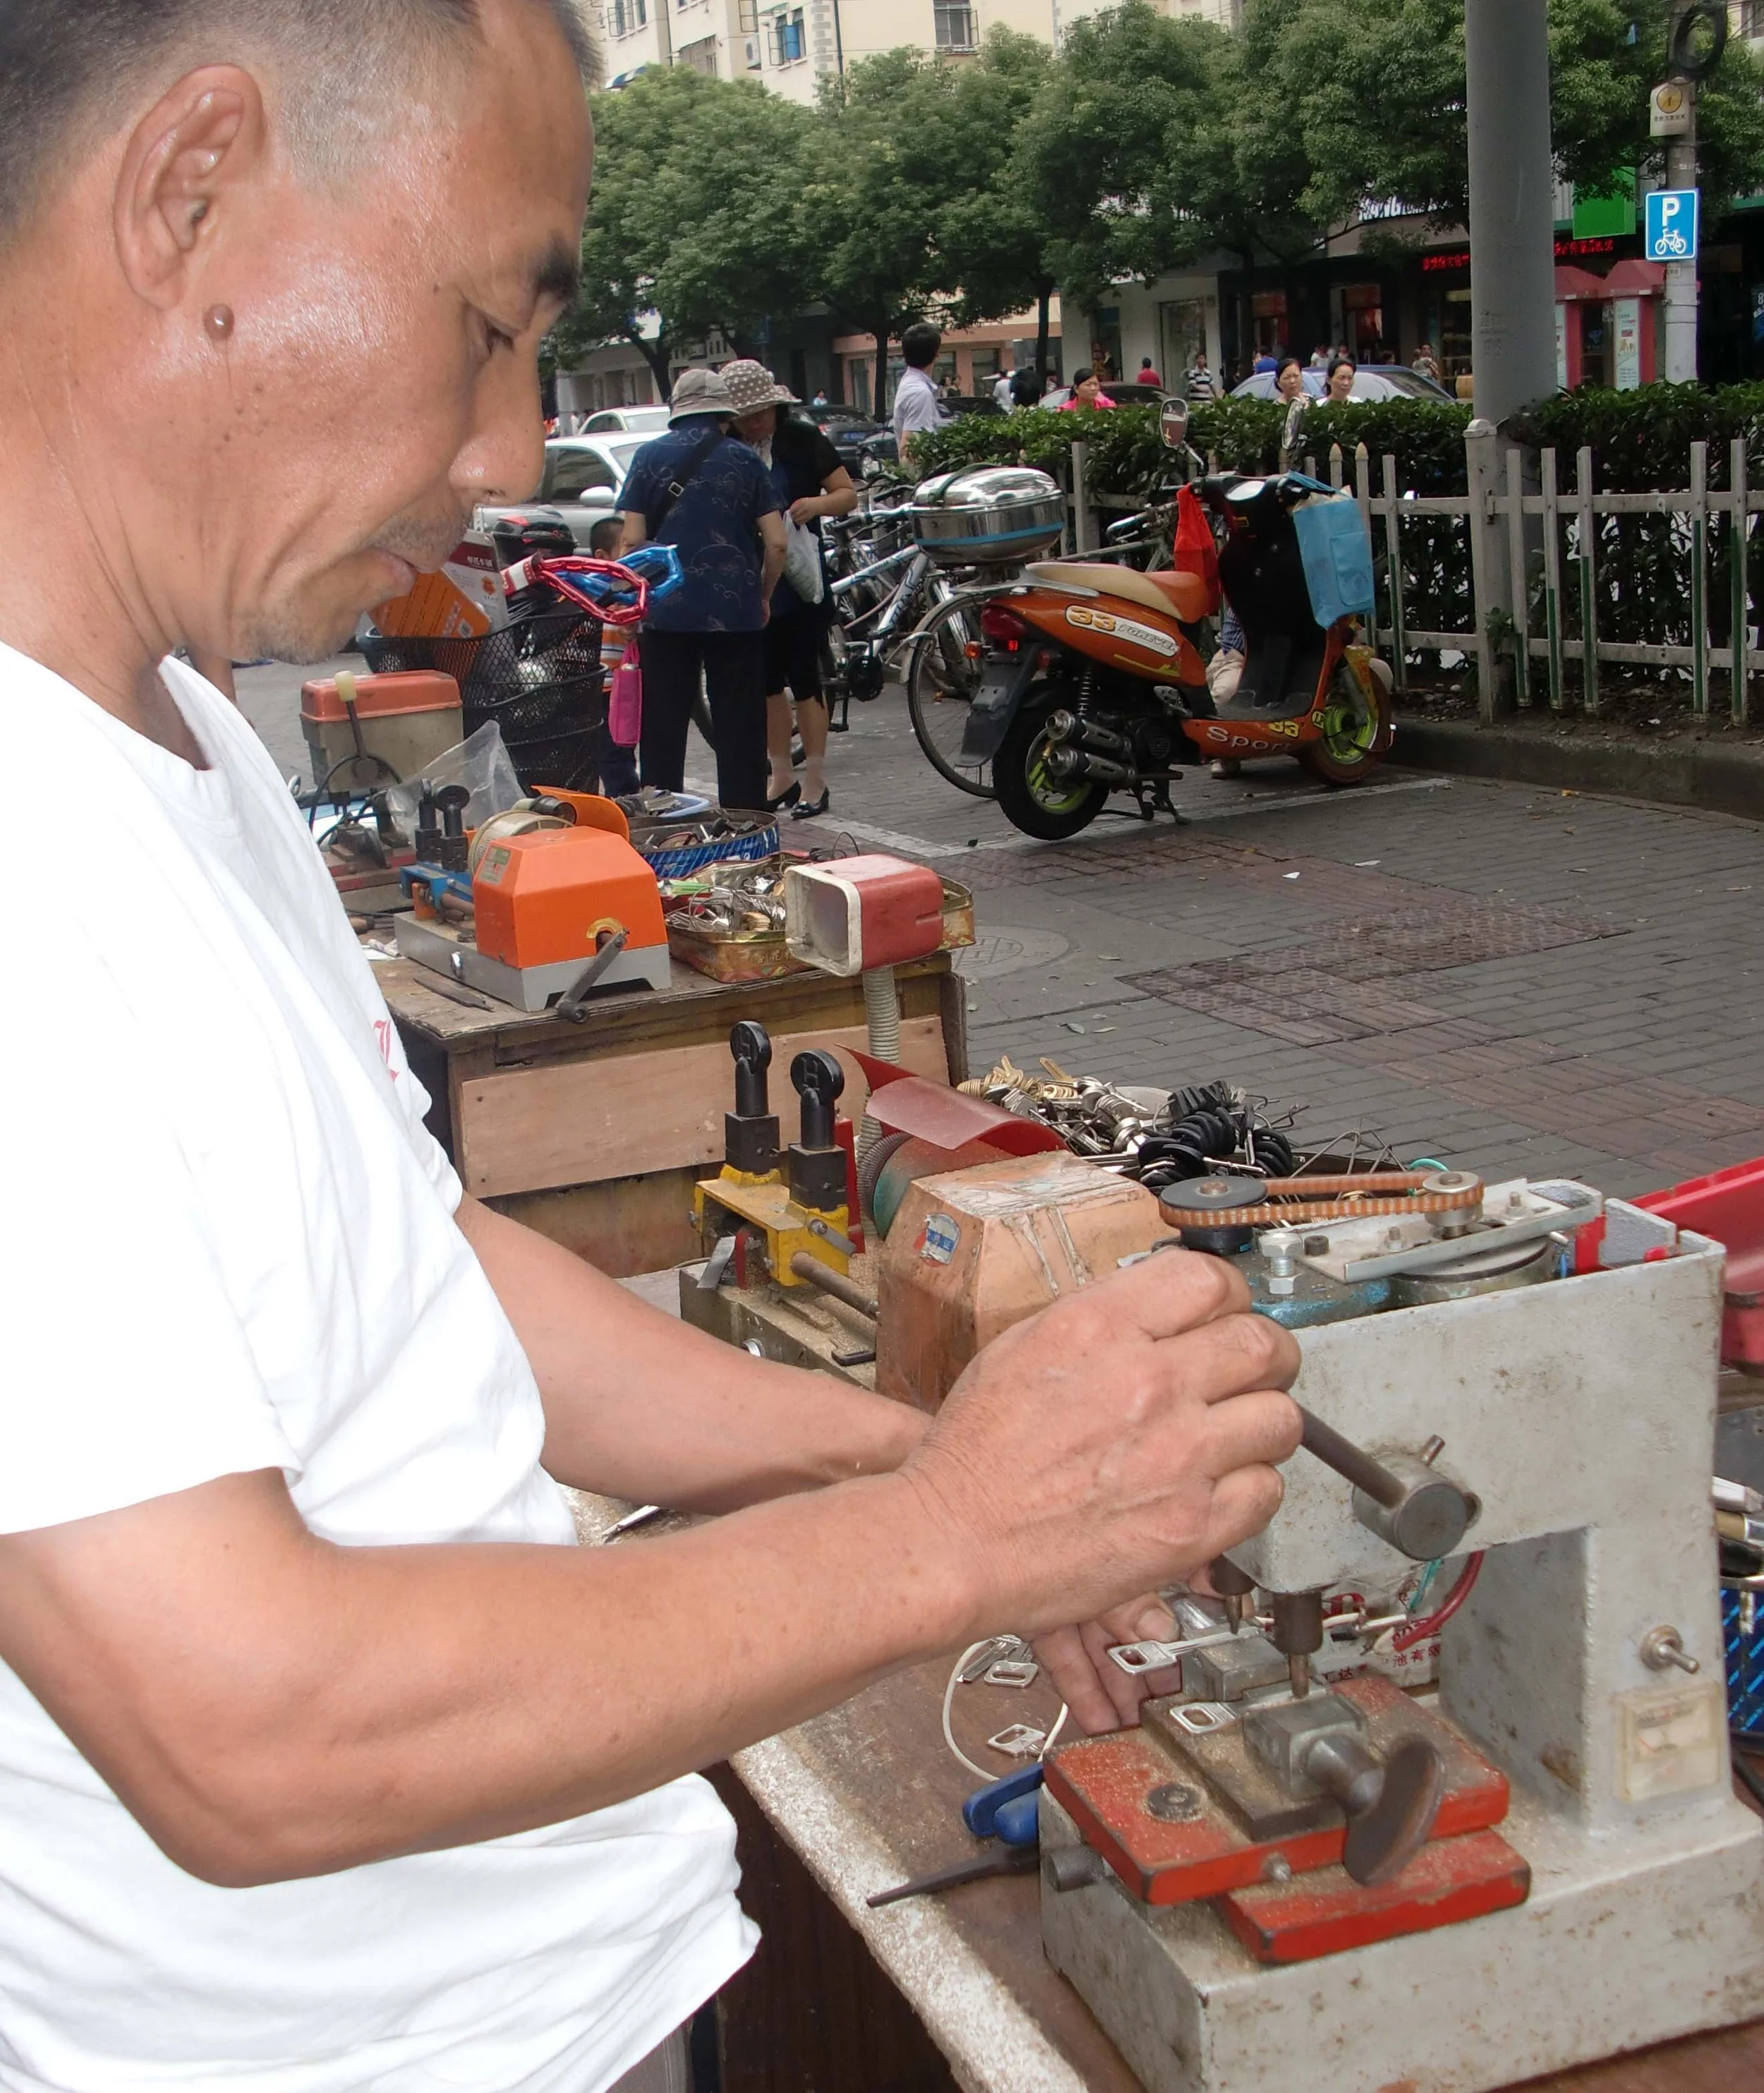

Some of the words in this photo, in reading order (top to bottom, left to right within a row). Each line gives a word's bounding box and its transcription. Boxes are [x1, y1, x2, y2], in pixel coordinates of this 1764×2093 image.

[1662, 197, 1679, 227] P
[1069, 608, 1116, 632] 33
[1206, 725, 1291, 752] Sport
